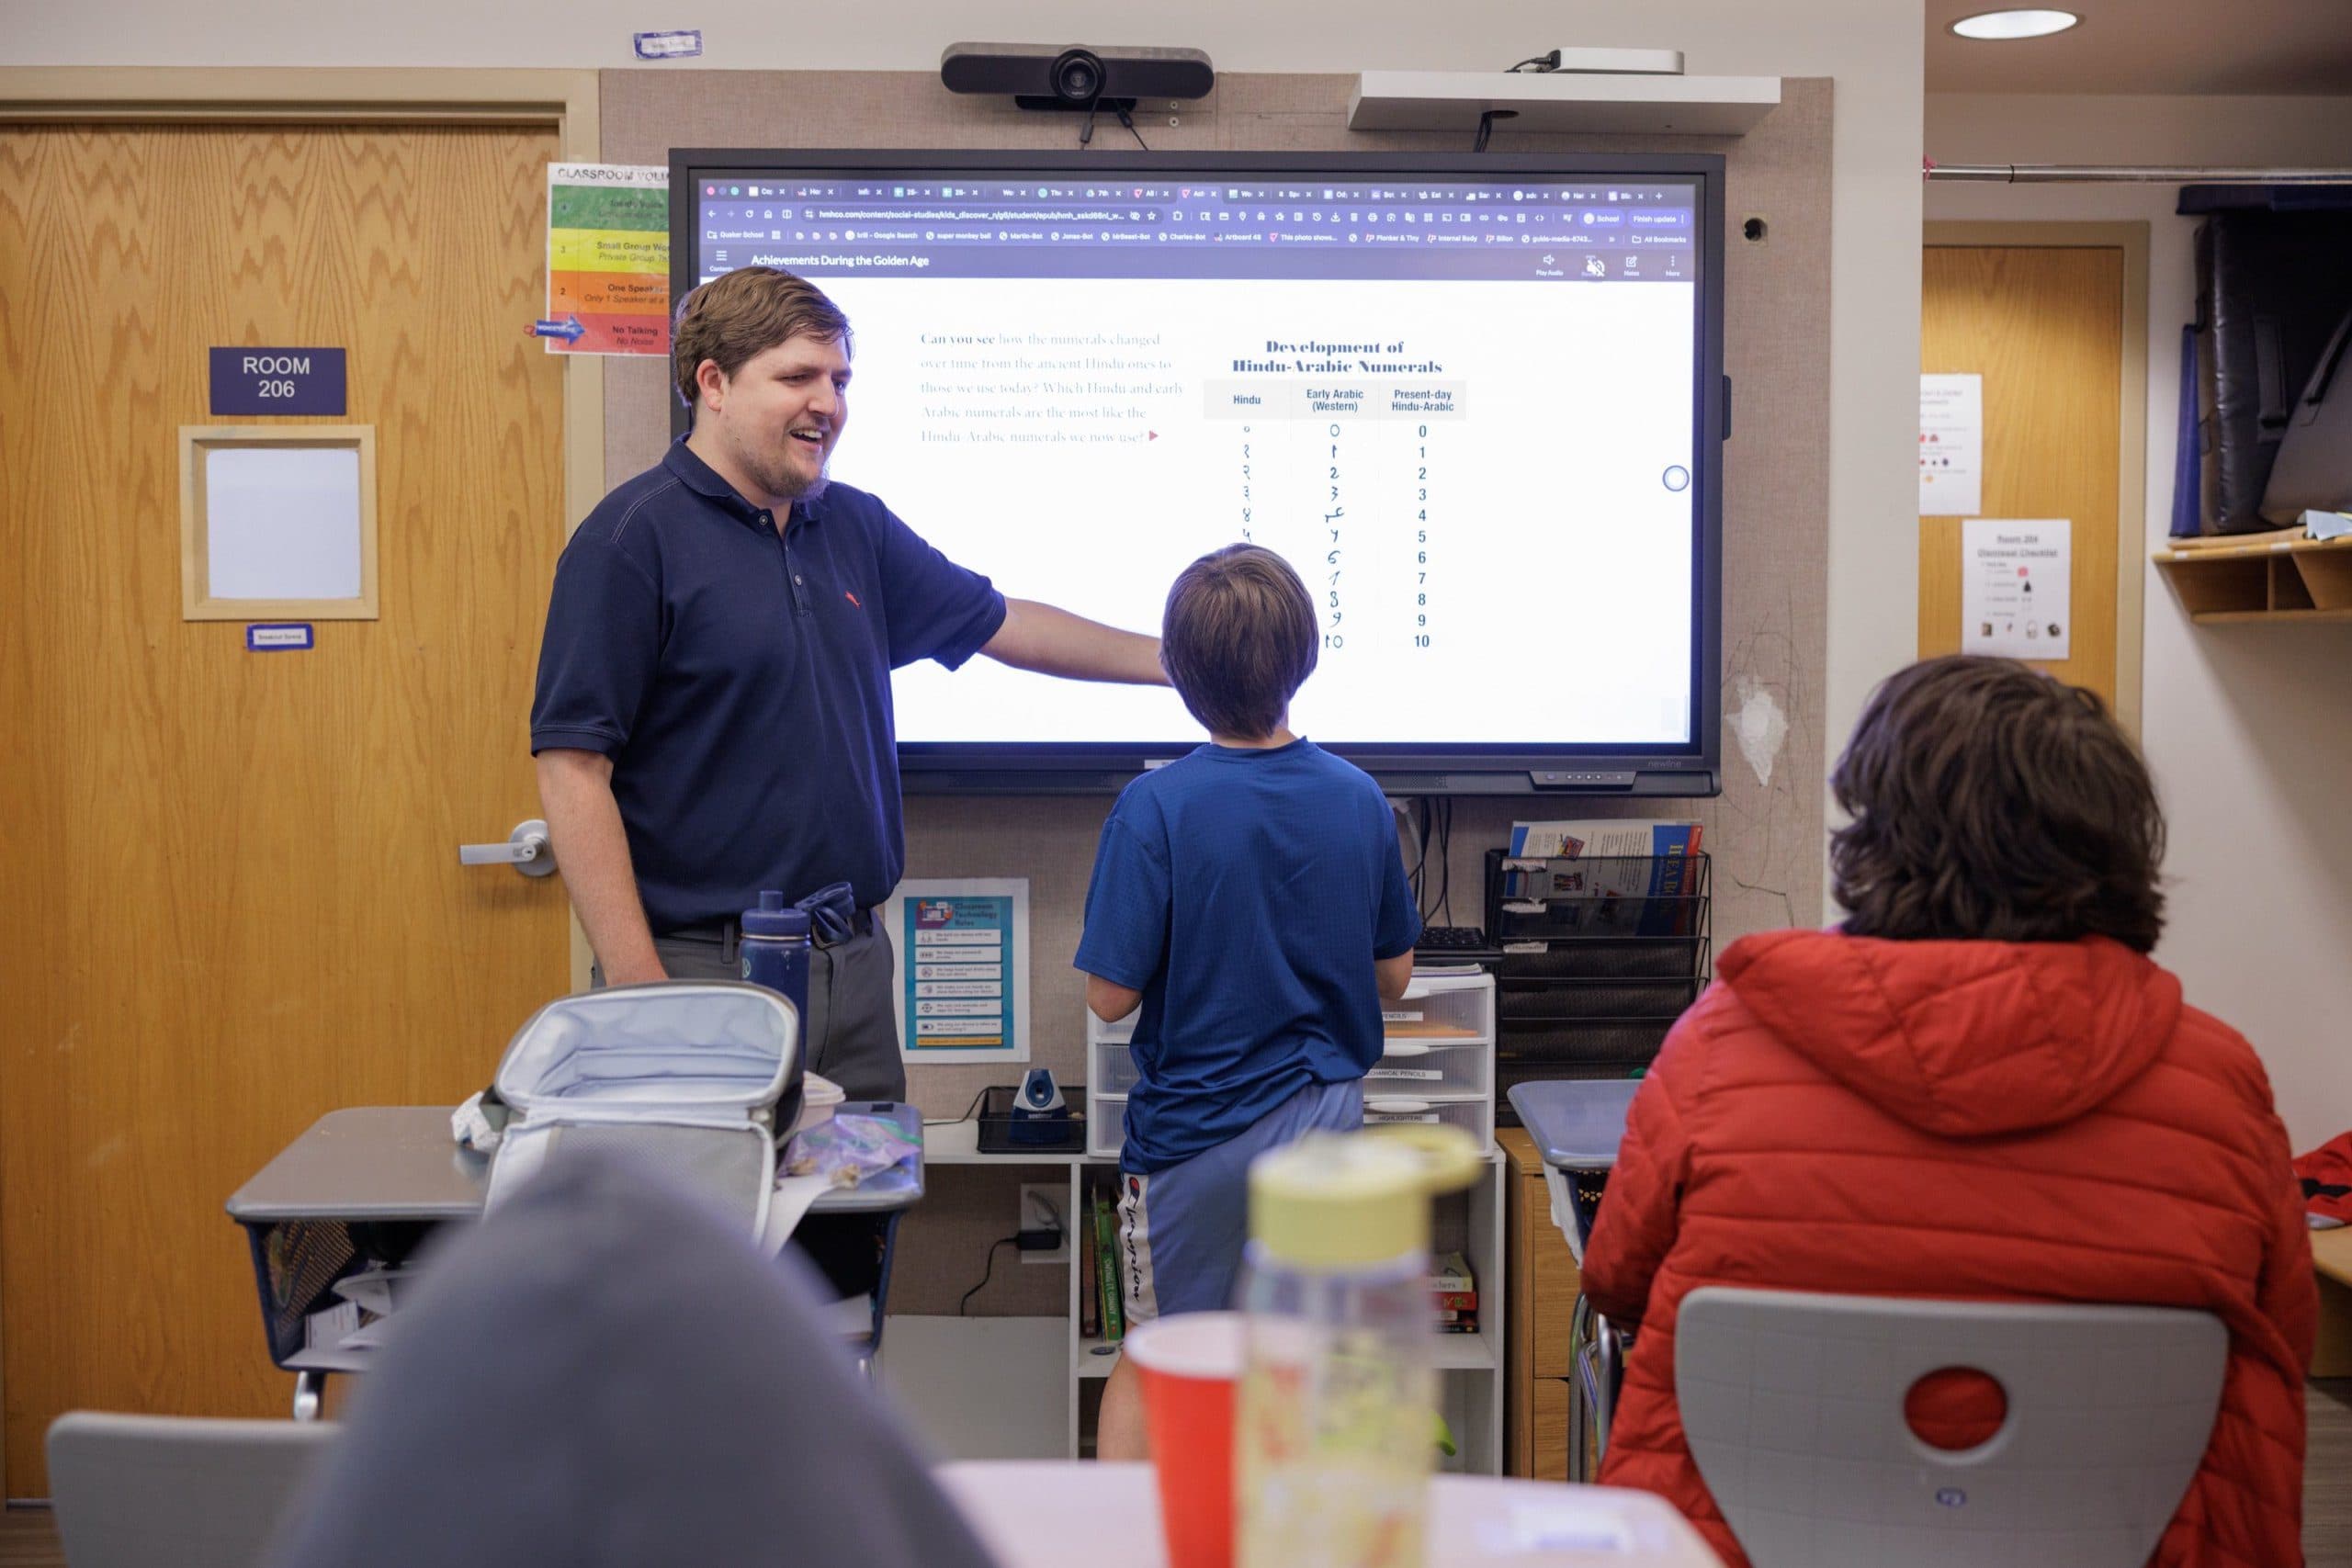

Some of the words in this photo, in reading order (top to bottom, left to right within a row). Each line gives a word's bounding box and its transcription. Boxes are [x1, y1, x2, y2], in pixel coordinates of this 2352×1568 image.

[1654, 216, 1677, 224] update
[875, 232, 896, 241] Google
[597, 242, 621, 250] Small
[624, 243, 651, 253] Group
[752, 255, 819, 266] Achievements
[820, 255, 854, 268] During
[855, 255, 872, 266] the
[873, 255, 909, 267] Golden
[910, 256, 930, 268] Age
[560, 288, 567, 296] 2
[607, 284, 625, 292] One
[584, 294, 604, 304] Only
[612, 325, 625, 334] No
[628, 326, 659, 337] Talking
[921, 333, 946, 345] Can
[948, 335, 973, 350] you
[976, 335, 996, 345] see
[1266, 341, 1380, 356] Development
[1385, 341, 1405, 353] of
[243, 355, 311, 376] ROOM
[1232, 359, 1352, 373] Hindu-Arabic
[1358, 360, 1443, 373] Numerals
[258, 378, 296, 398] 206
[1232, 394, 1261, 405] Hindu
[1306, 389, 1330, 400] Early
[1333, 389, 1363, 400] Arabic
[1394, 389, 1452, 401] Present-day
[1312, 401, 1358, 412] (Western)
[1392, 401, 1454, 412] Hindu-Arabic
[1419, 446, 1426, 458] 1
[1419, 467, 1427, 479] 2
[1419, 488, 1426, 502] 3
[1418, 509, 1427, 522] 4
[1418, 530, 1426, 543] 5
[1328, 550, 1340, 564] 6
[1418, 551, 1426, 564] 6
[1418, 572, 1426, 584] 7
[1329, 591, 1339, 607] 8
[1418, 593, 1426, 606] 8
[1418, 615, 1426, 626] 9
[1325, 634, 1343, 649] 10
[1414, 635, 1430, 648] 10
